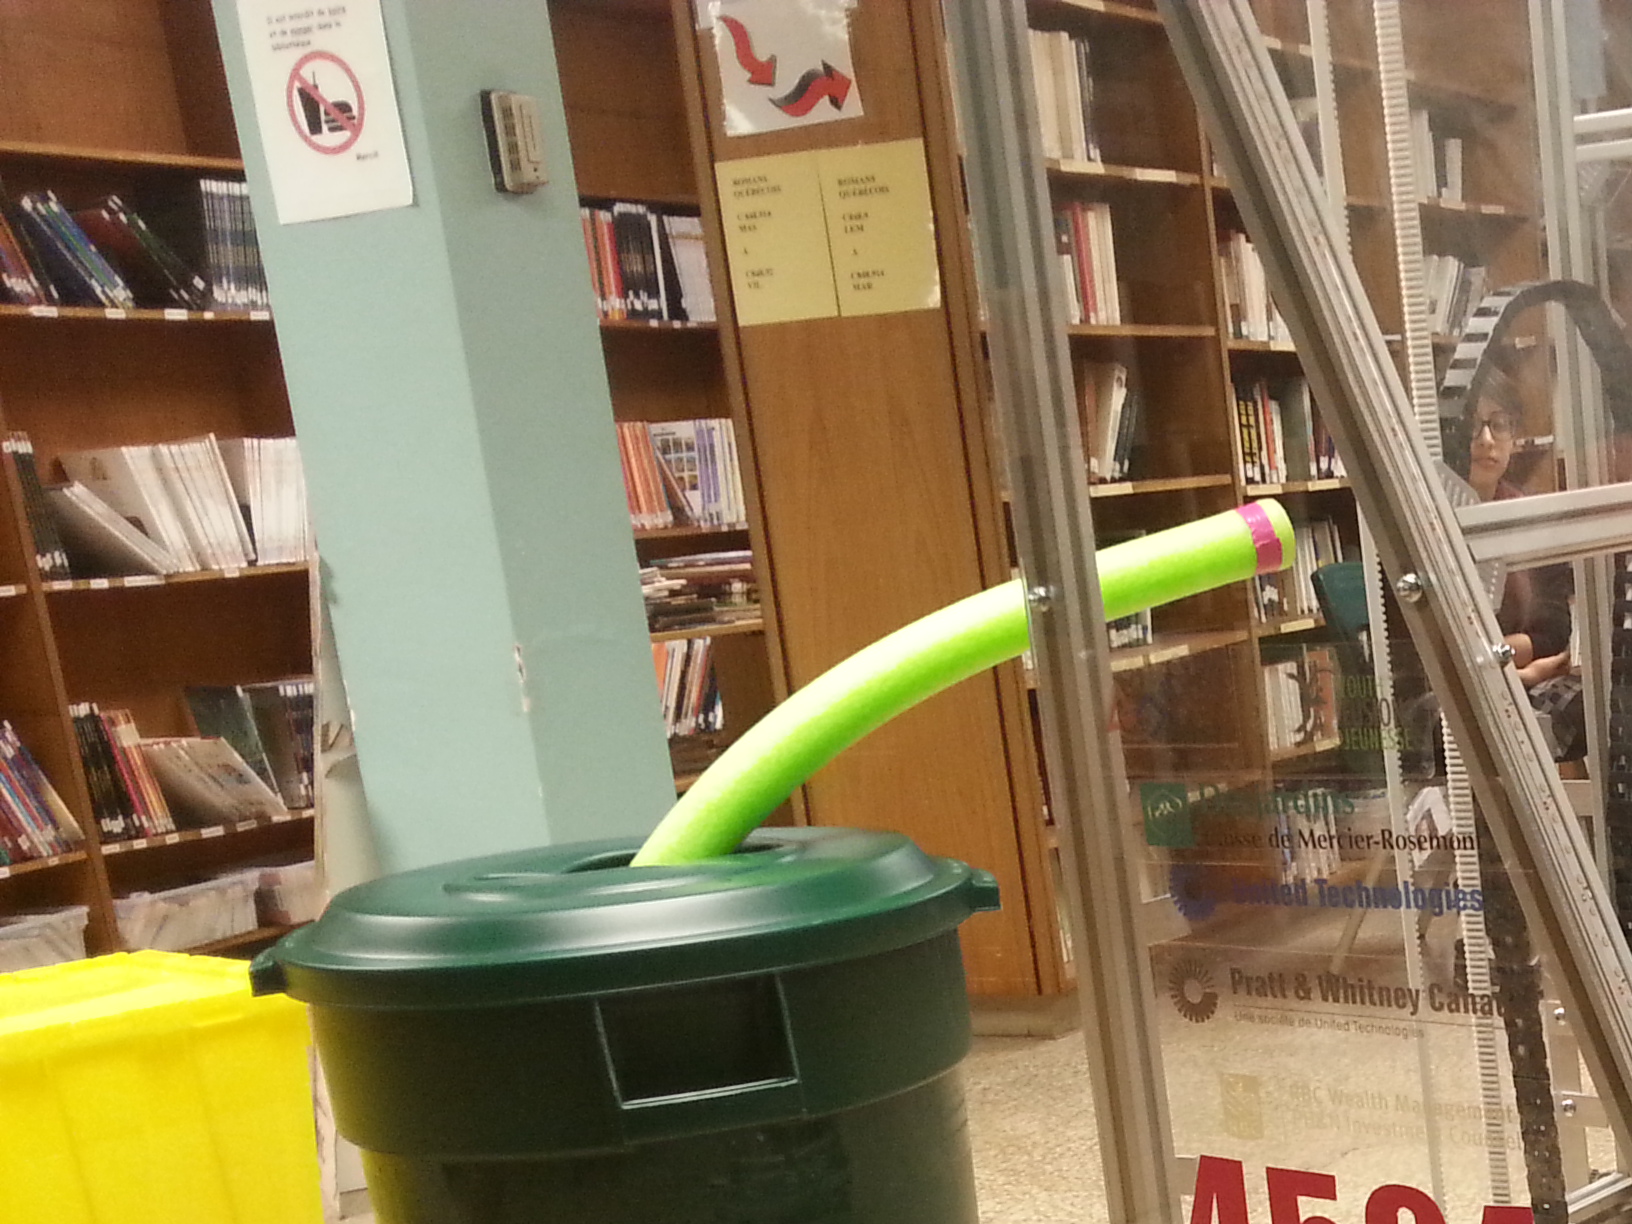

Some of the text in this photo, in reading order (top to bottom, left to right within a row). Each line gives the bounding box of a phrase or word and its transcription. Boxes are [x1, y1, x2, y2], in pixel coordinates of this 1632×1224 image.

[1315, 879, 1484, 917] Technologies
[1230, 967, 1288, 1000] Pratt
[1293, 973, 1312, 1001] &
[1317, 972, 1421, 1016] Whitney
